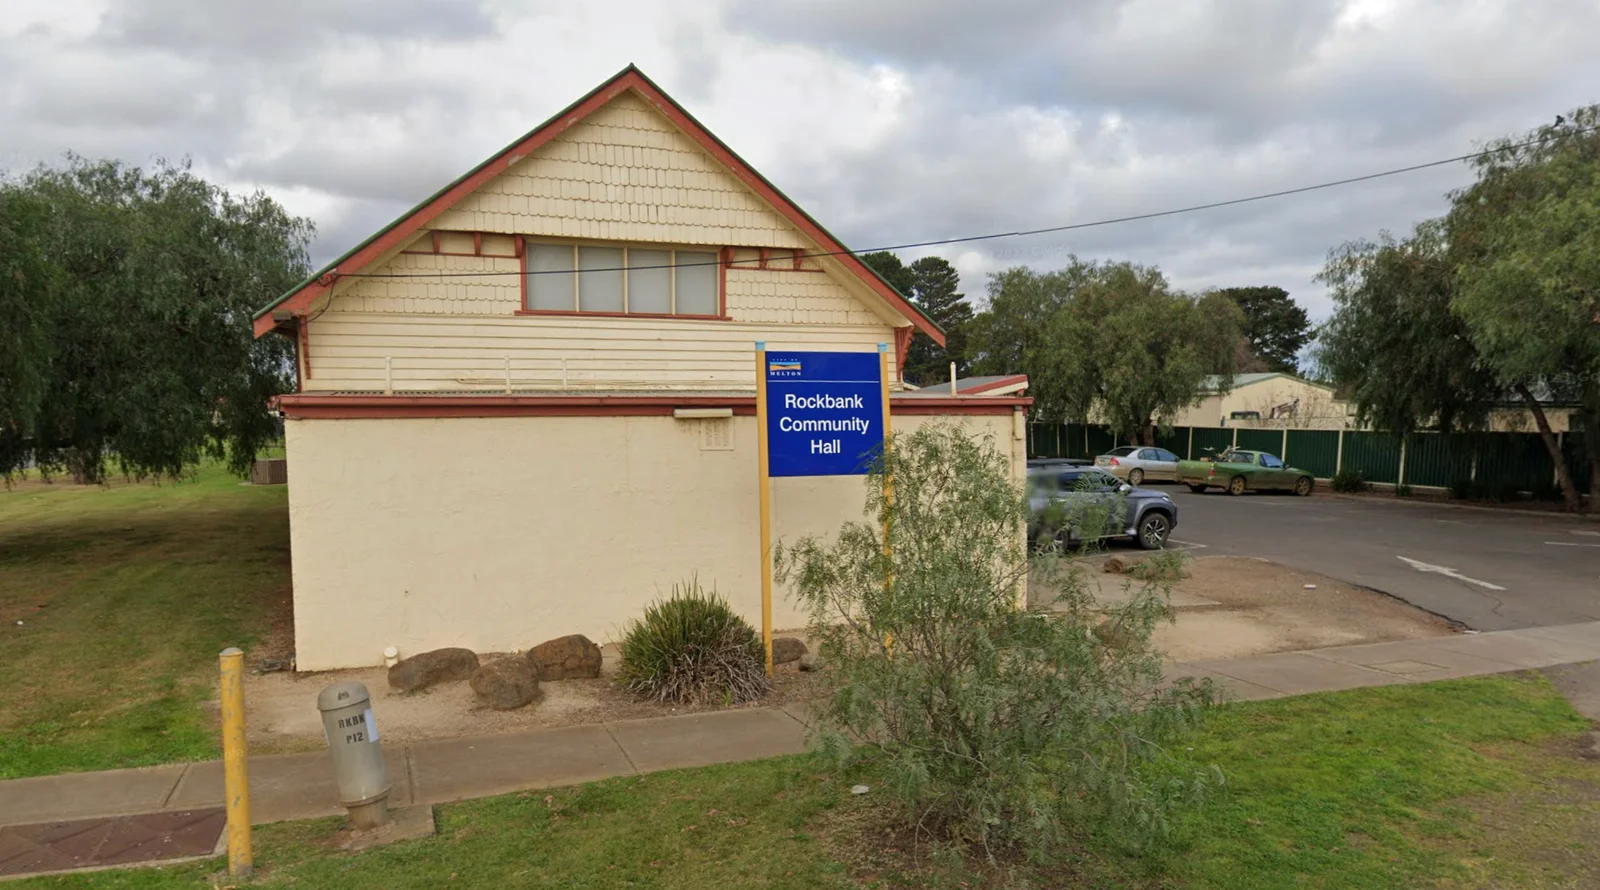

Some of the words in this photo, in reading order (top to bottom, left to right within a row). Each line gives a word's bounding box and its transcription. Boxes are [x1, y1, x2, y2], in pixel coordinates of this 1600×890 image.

[785, 394, 864, 409] Rockbank
[780, 416, 869, 434] Community
[811, 439, 841, 454] Hall
